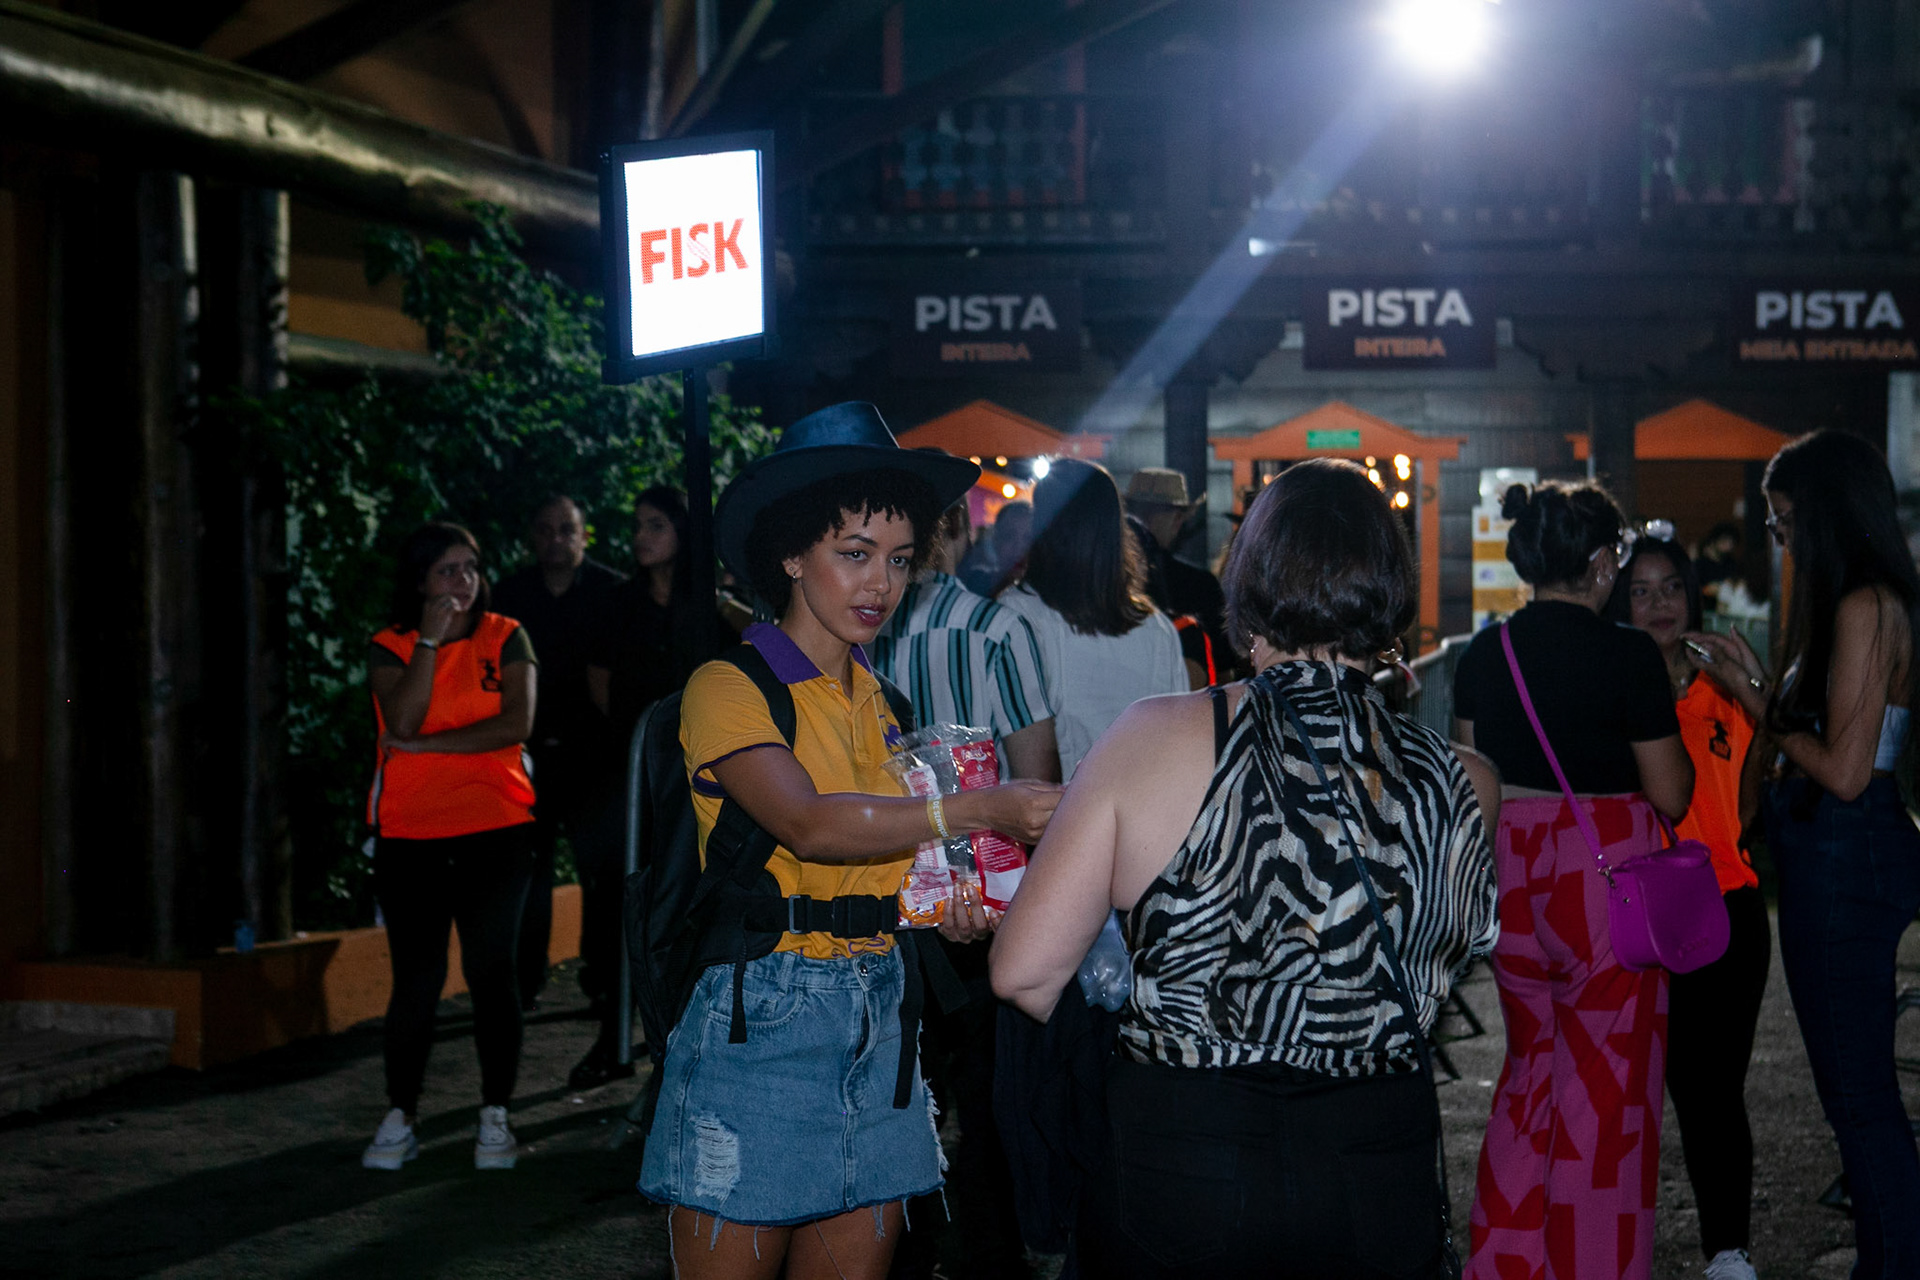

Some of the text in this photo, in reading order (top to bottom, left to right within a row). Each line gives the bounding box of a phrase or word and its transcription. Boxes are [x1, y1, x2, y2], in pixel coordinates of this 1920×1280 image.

[640, 217, 749, 285] FISK
[914, 294, 1057, 332] PISTA
[1328, 288, 1474, 328] PISTA
[1755, 290, 1905, 330] PISTA
[1354, 336, 1447, 358] INTEIRA
[1739, 339, 1918, 361] MEIA ENTRADA
